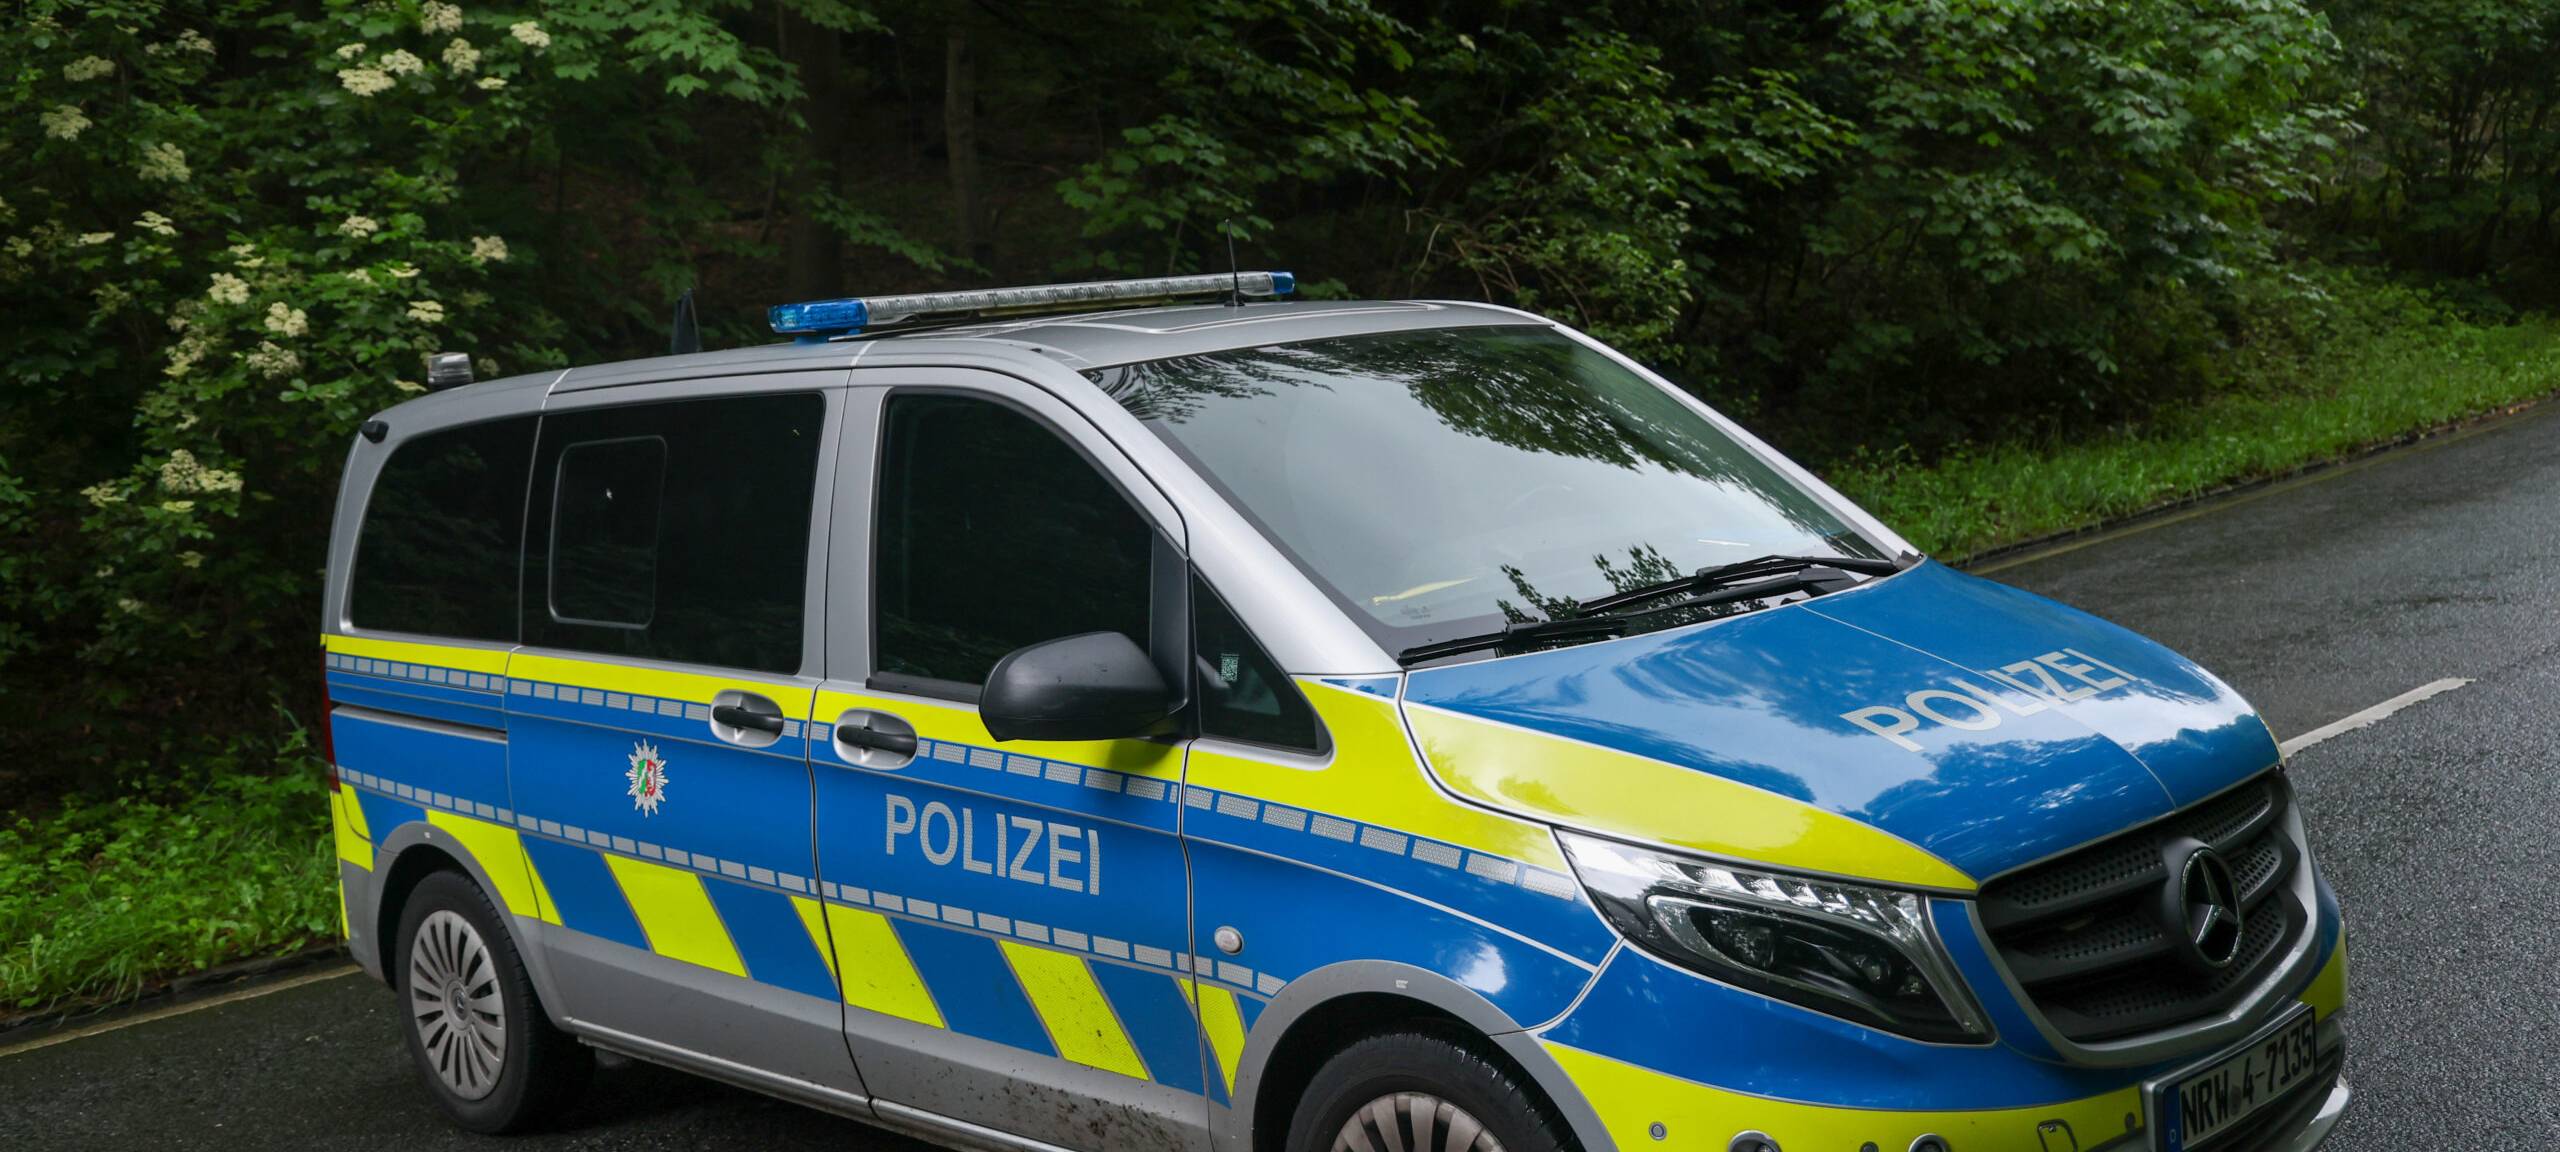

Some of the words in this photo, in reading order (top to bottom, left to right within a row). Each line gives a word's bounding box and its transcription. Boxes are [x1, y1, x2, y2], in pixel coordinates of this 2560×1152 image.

[1839, 647, 2138, 752] POLIZEI
[886, 793, 1100, 896] POLIZEI
[2180, 1069, 2229, 1141] NRW
[2242, 1018, 2313, 1105] 4-7135
